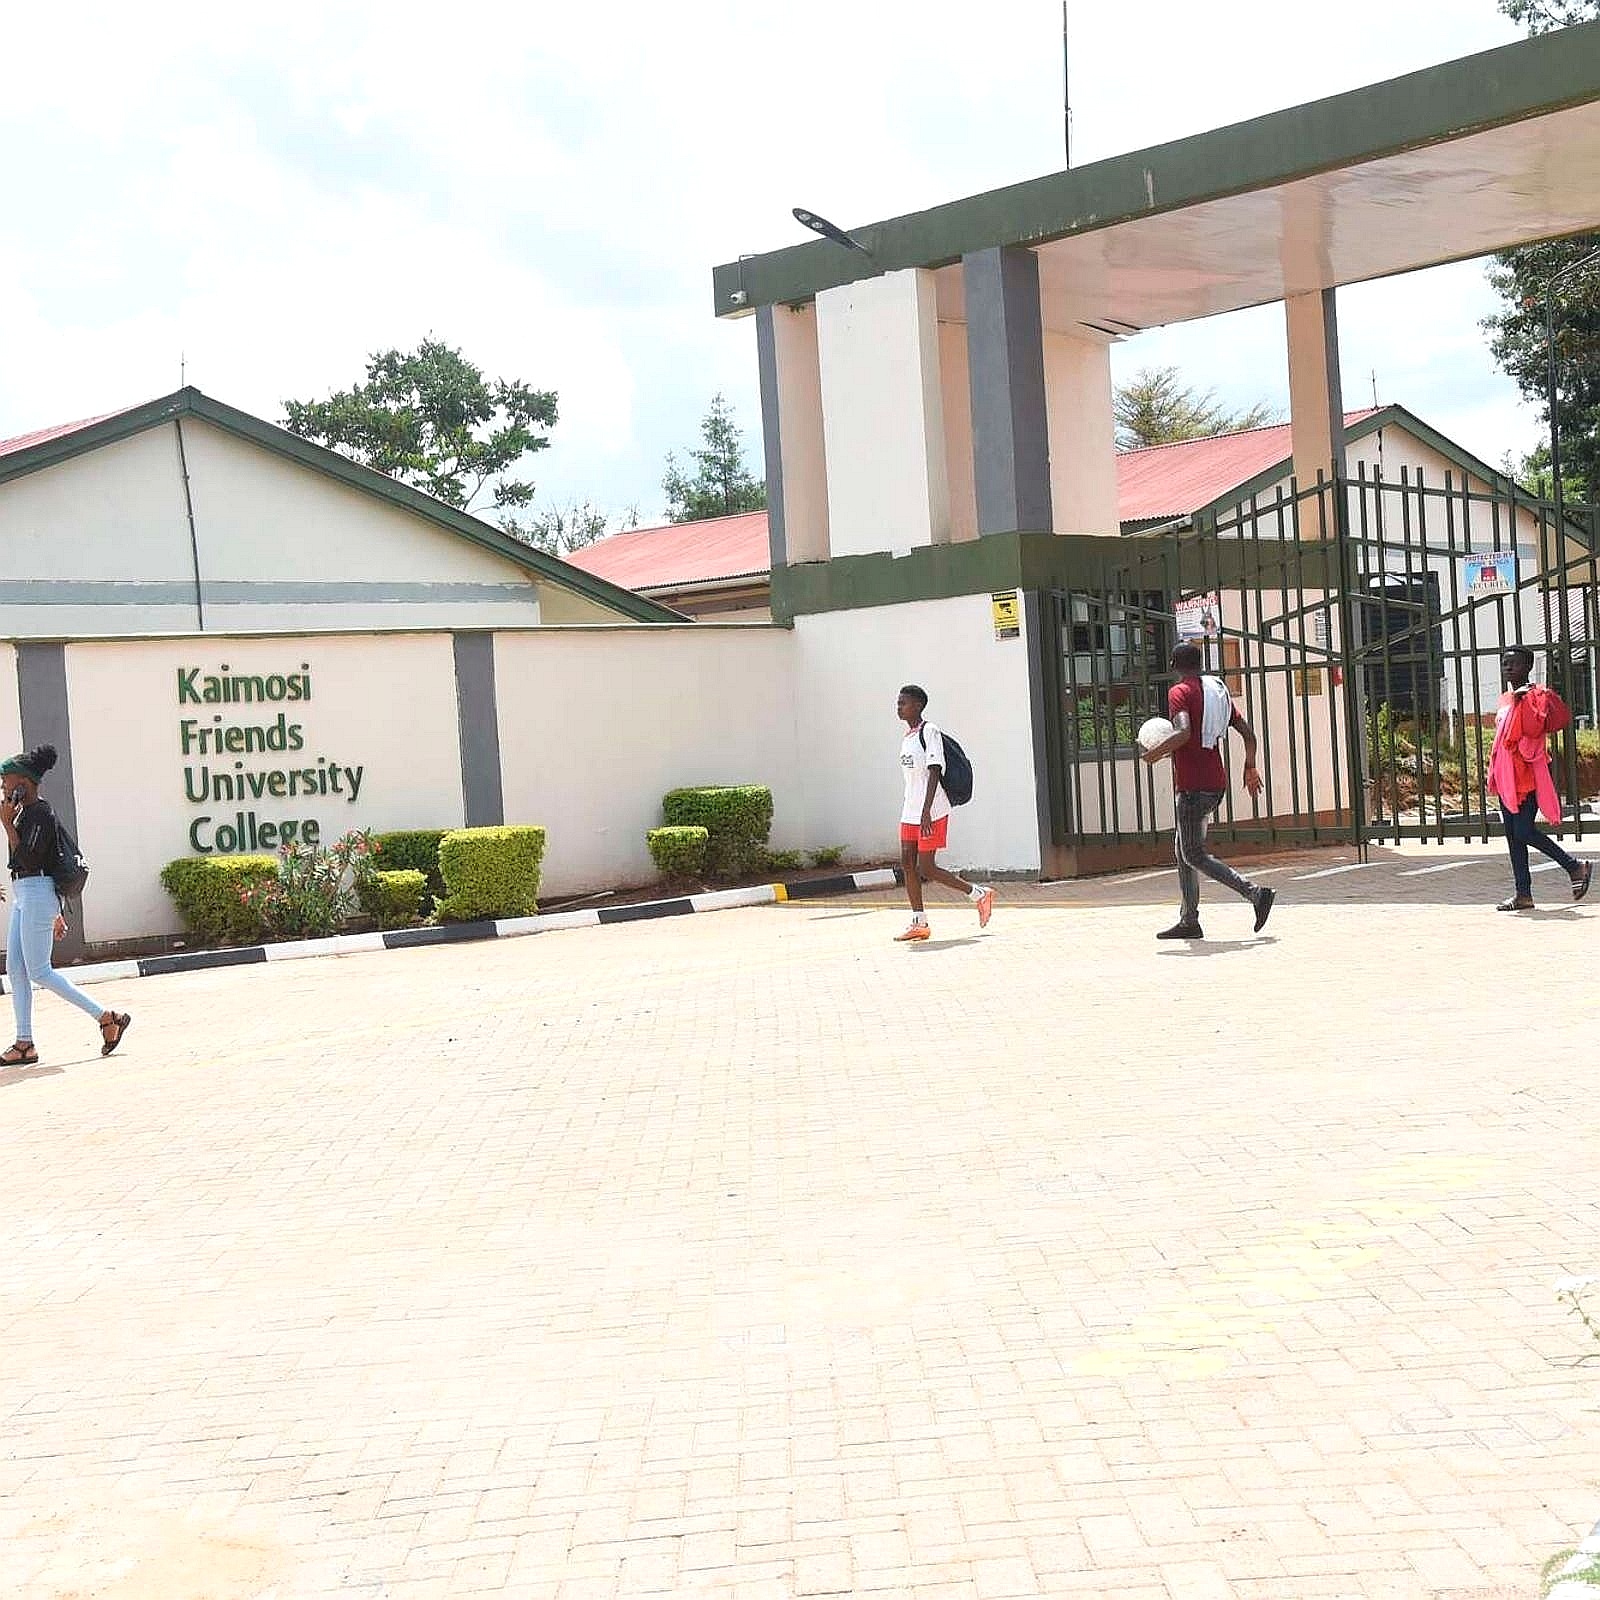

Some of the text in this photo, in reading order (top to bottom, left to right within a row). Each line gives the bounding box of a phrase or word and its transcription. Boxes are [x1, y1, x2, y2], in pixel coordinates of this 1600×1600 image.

[178, 664, 311, 704] Kaimosi
[180, 713, 304, 755] Friends
[184, 757, 363, 803] University
